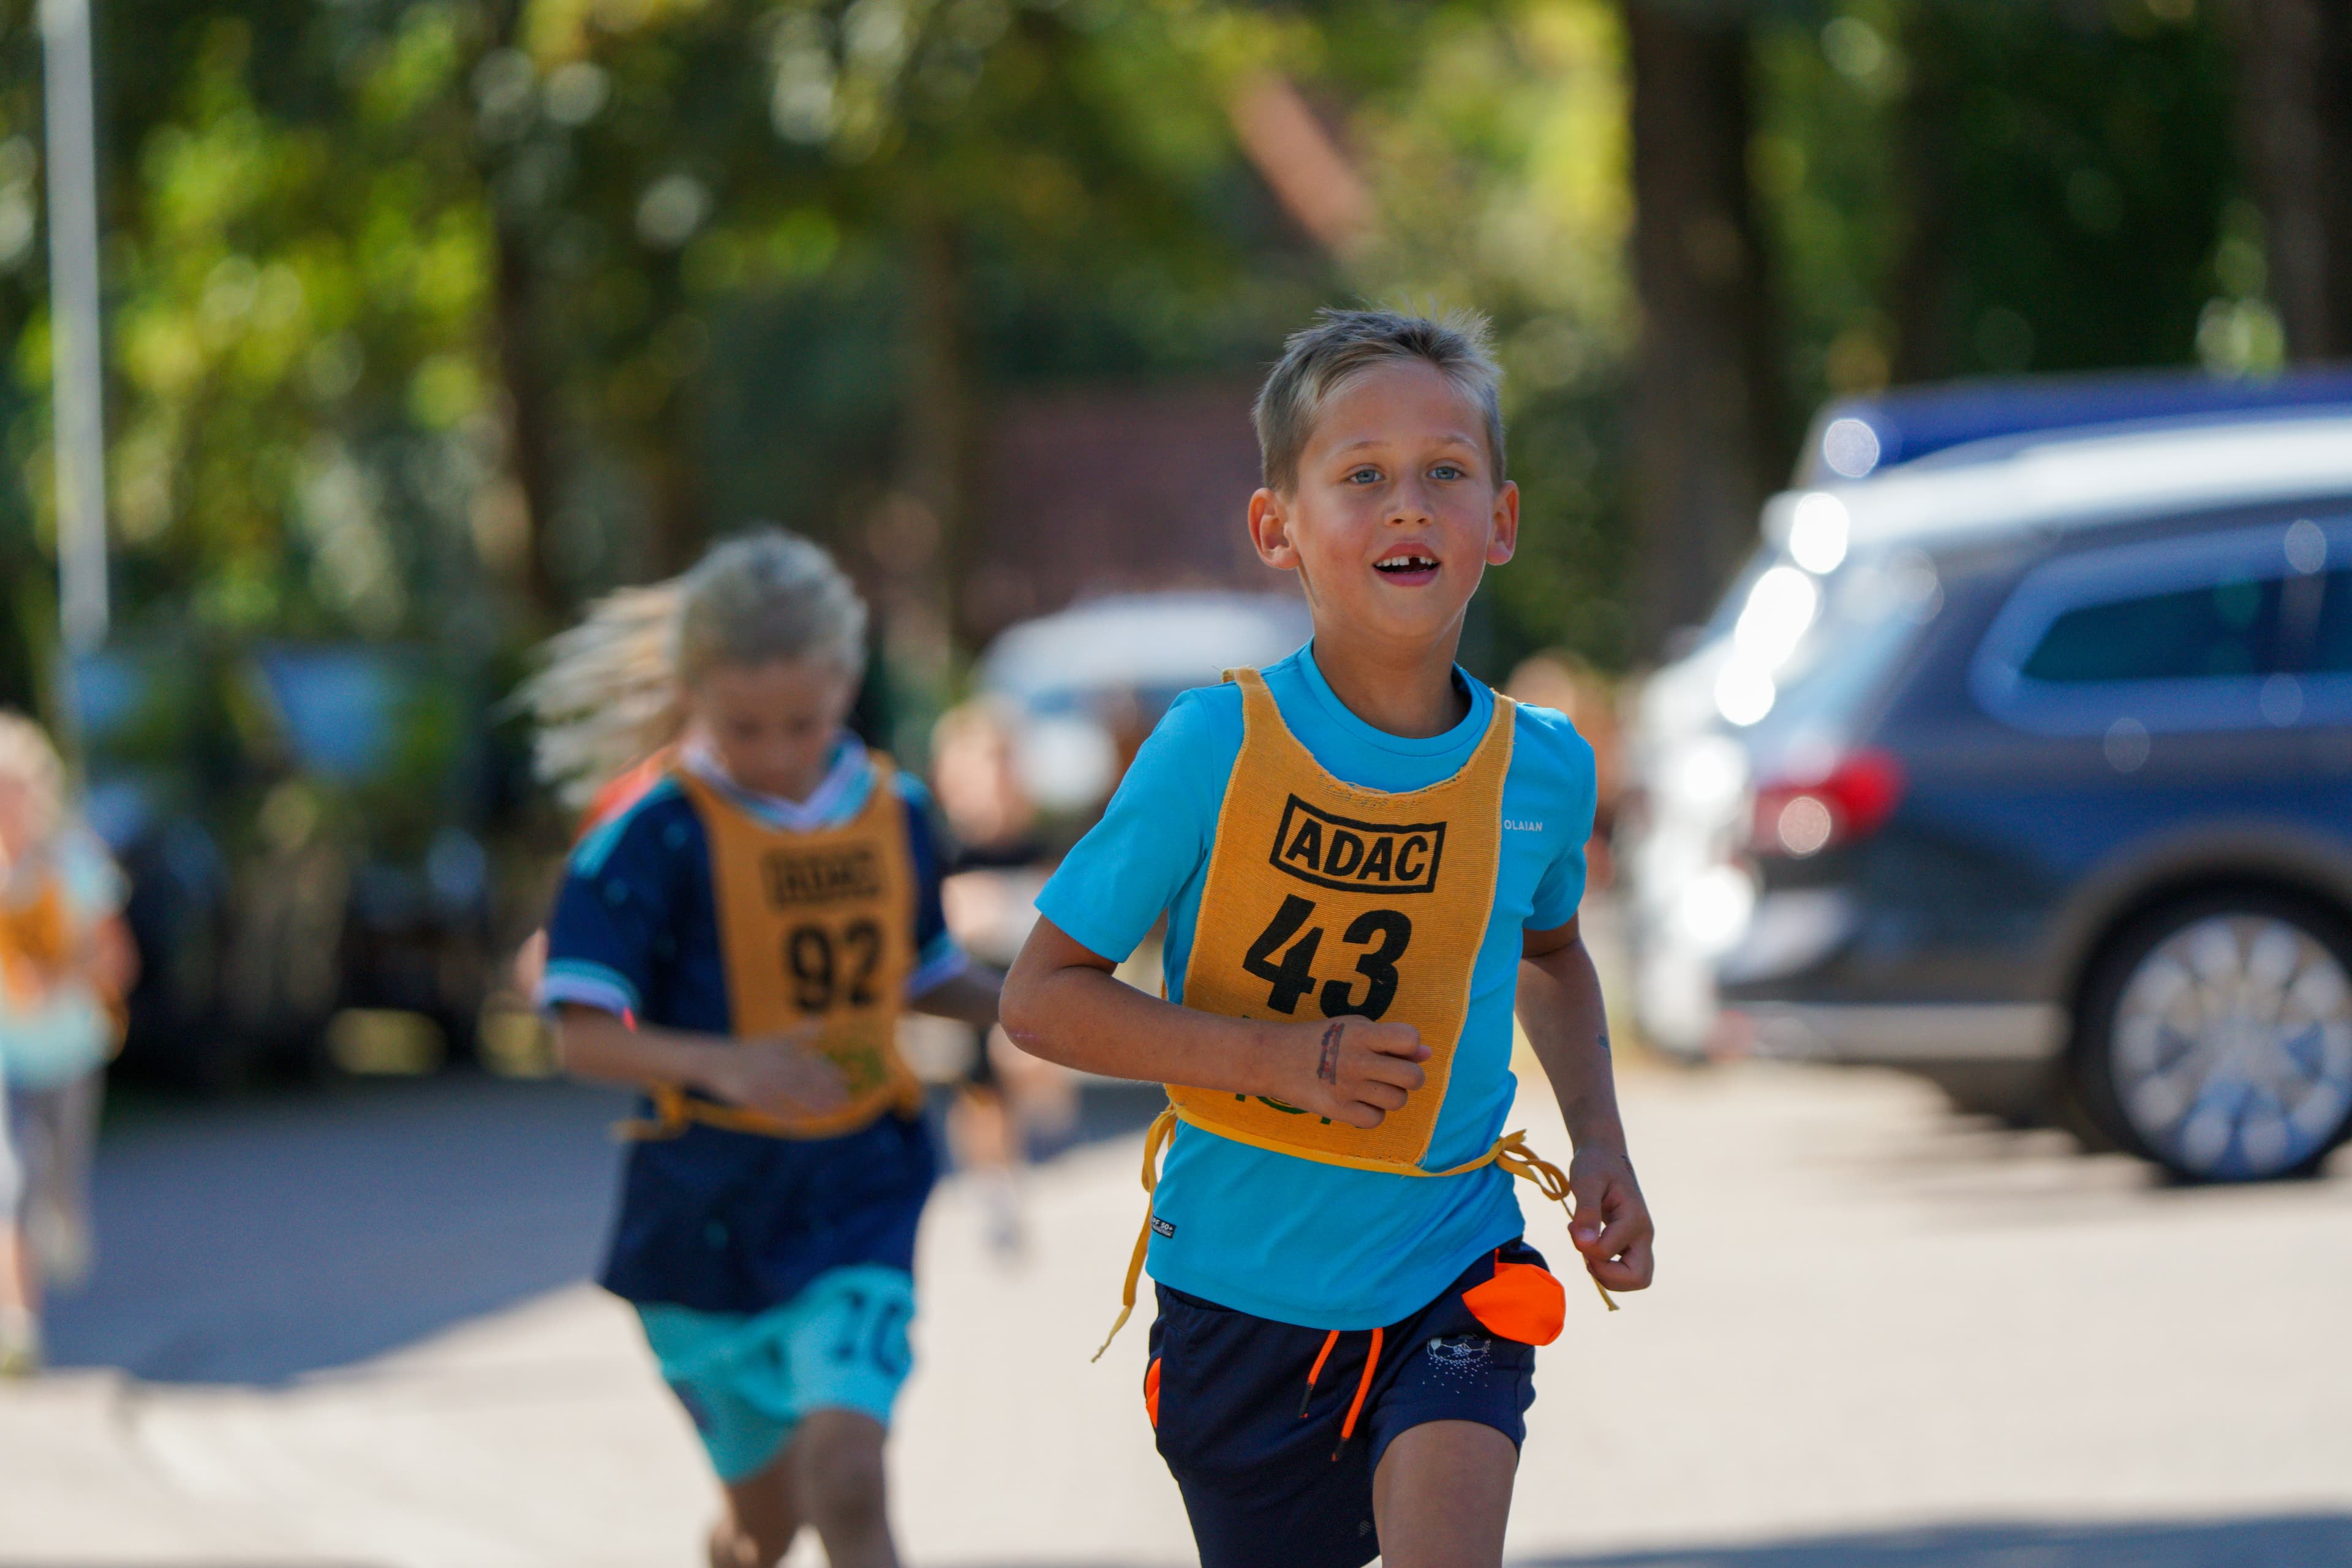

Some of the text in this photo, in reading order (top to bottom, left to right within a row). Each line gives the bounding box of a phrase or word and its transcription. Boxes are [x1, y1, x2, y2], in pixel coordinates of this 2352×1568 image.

[1286, 818, 1428, 881] ADAC
[1504, 819, 1543, 832] OLAIAN
[786, 920, 884, 1015] 92
[1242, 893, 1412, 1022] 43
